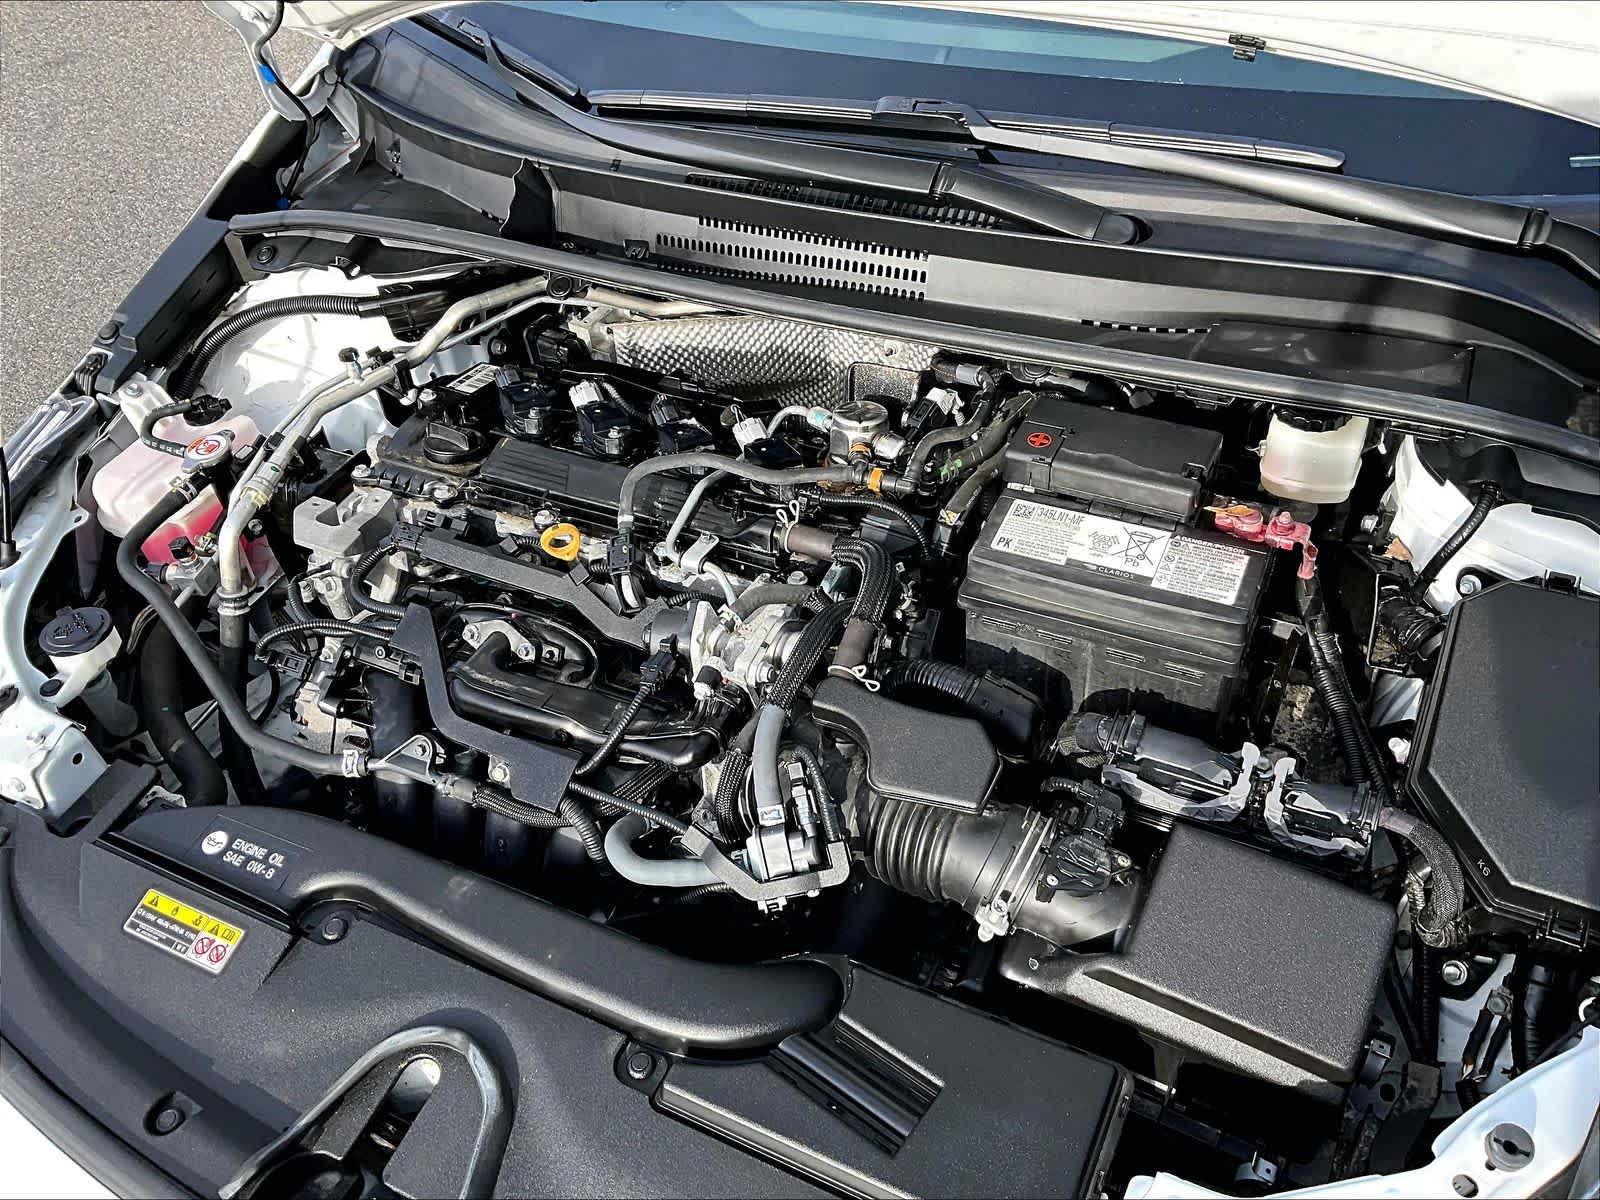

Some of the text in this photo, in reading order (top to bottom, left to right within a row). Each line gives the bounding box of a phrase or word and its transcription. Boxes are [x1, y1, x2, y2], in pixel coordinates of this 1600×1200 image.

[996, 536, 1013, 549] PK
[1124, 557, 1140, 568] Pb
[231, 838, 286, 867] ENGINE OIL
[223, 851, 276, 879] SAE 0W-8
[1476, 859, 1491, 877] K6
